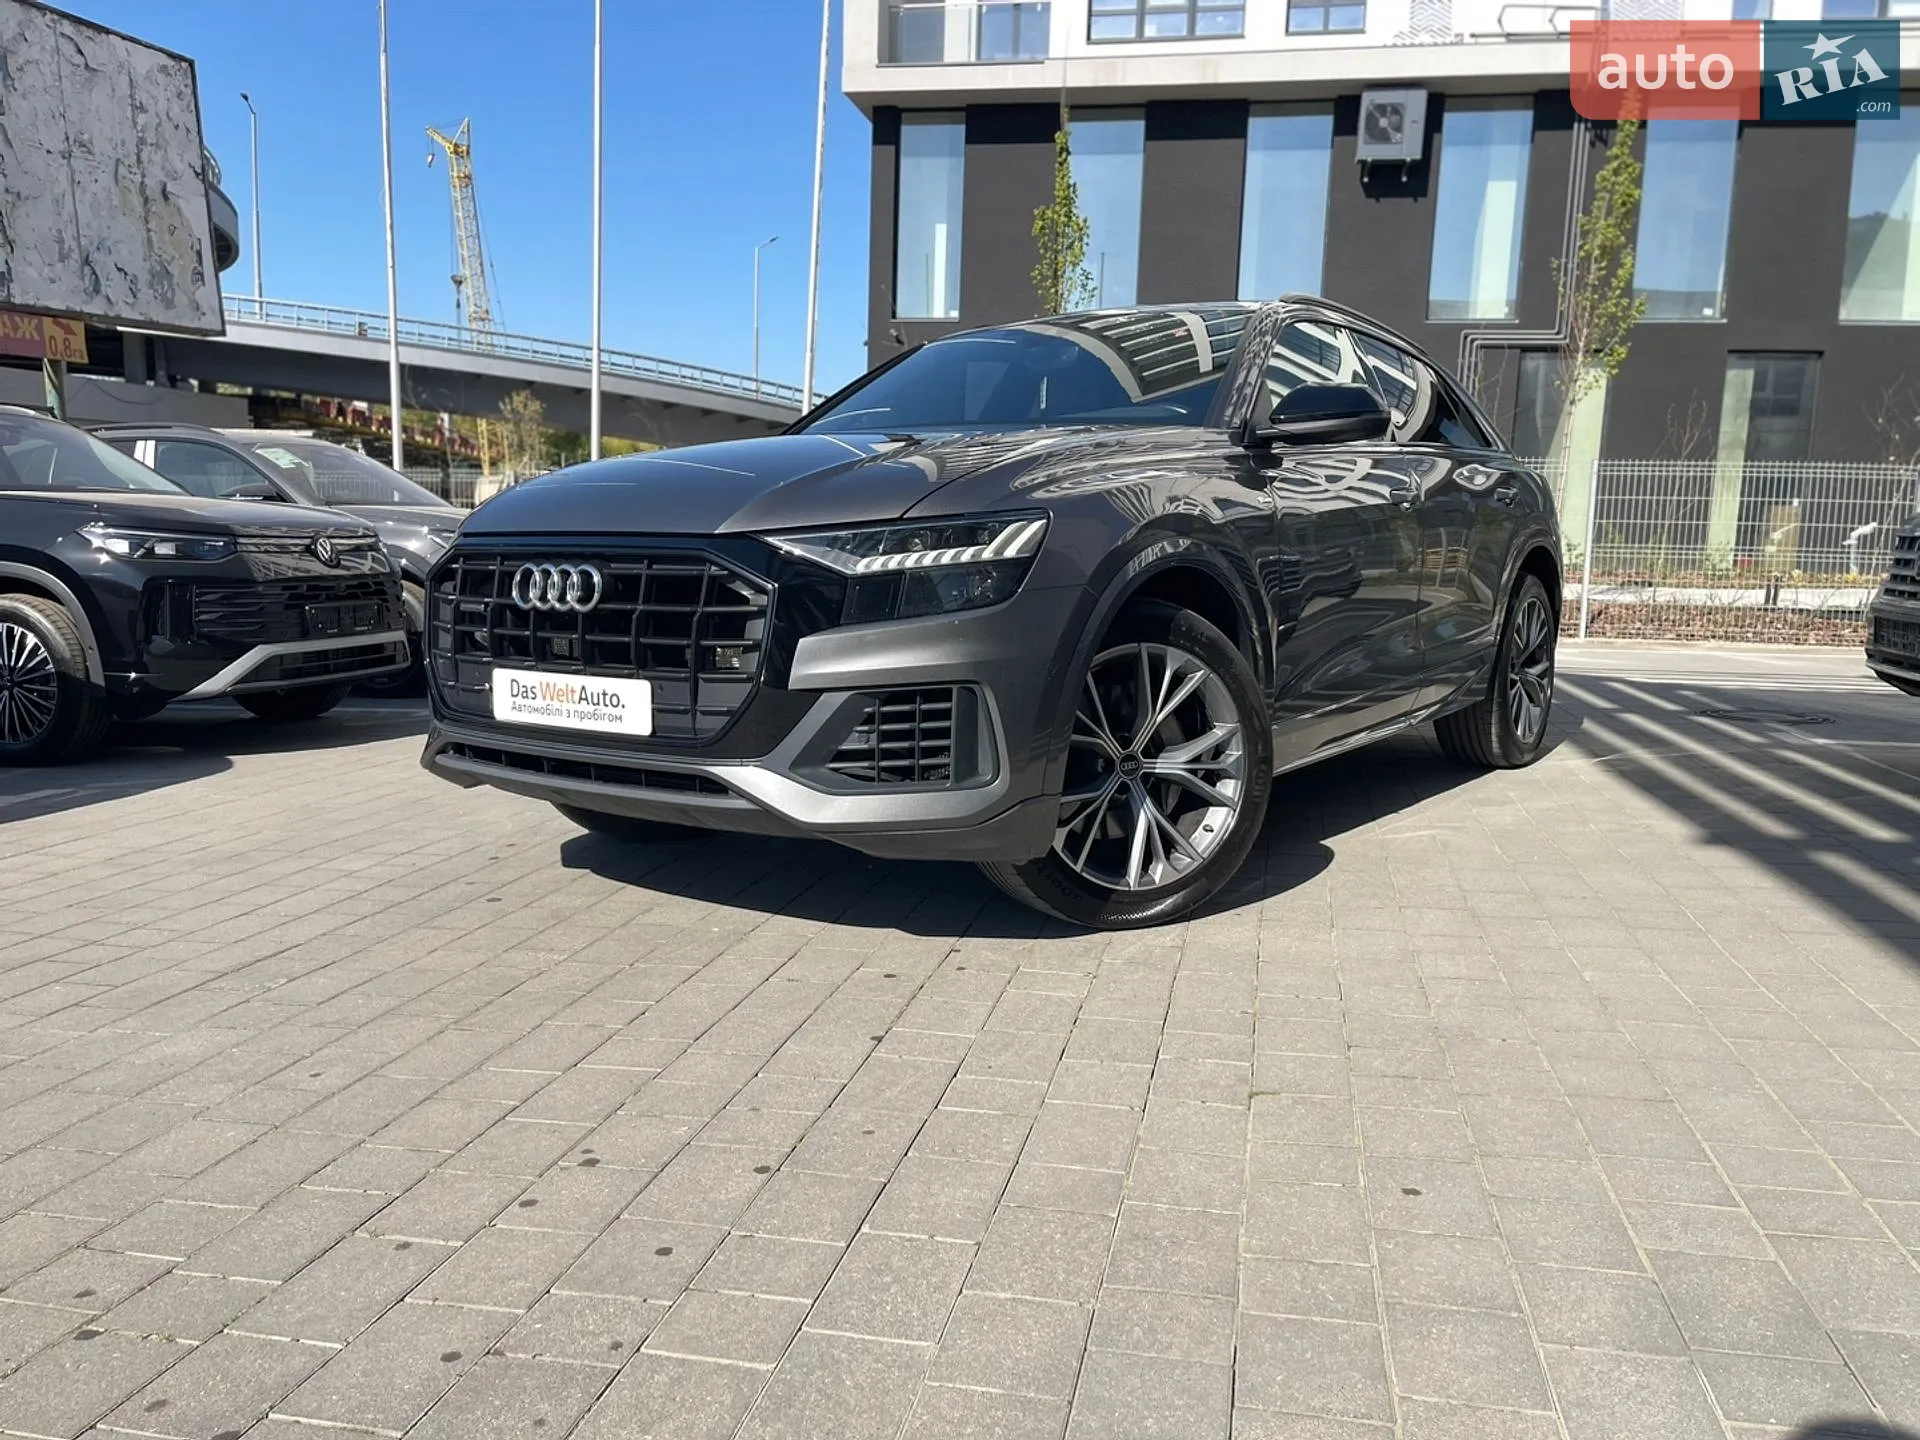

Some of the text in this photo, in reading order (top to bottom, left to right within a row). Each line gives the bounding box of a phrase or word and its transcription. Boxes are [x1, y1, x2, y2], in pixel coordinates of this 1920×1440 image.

[510, 678, 537, 700] Das
[511, 701, 623, 723] Автомобілі з пробігом
